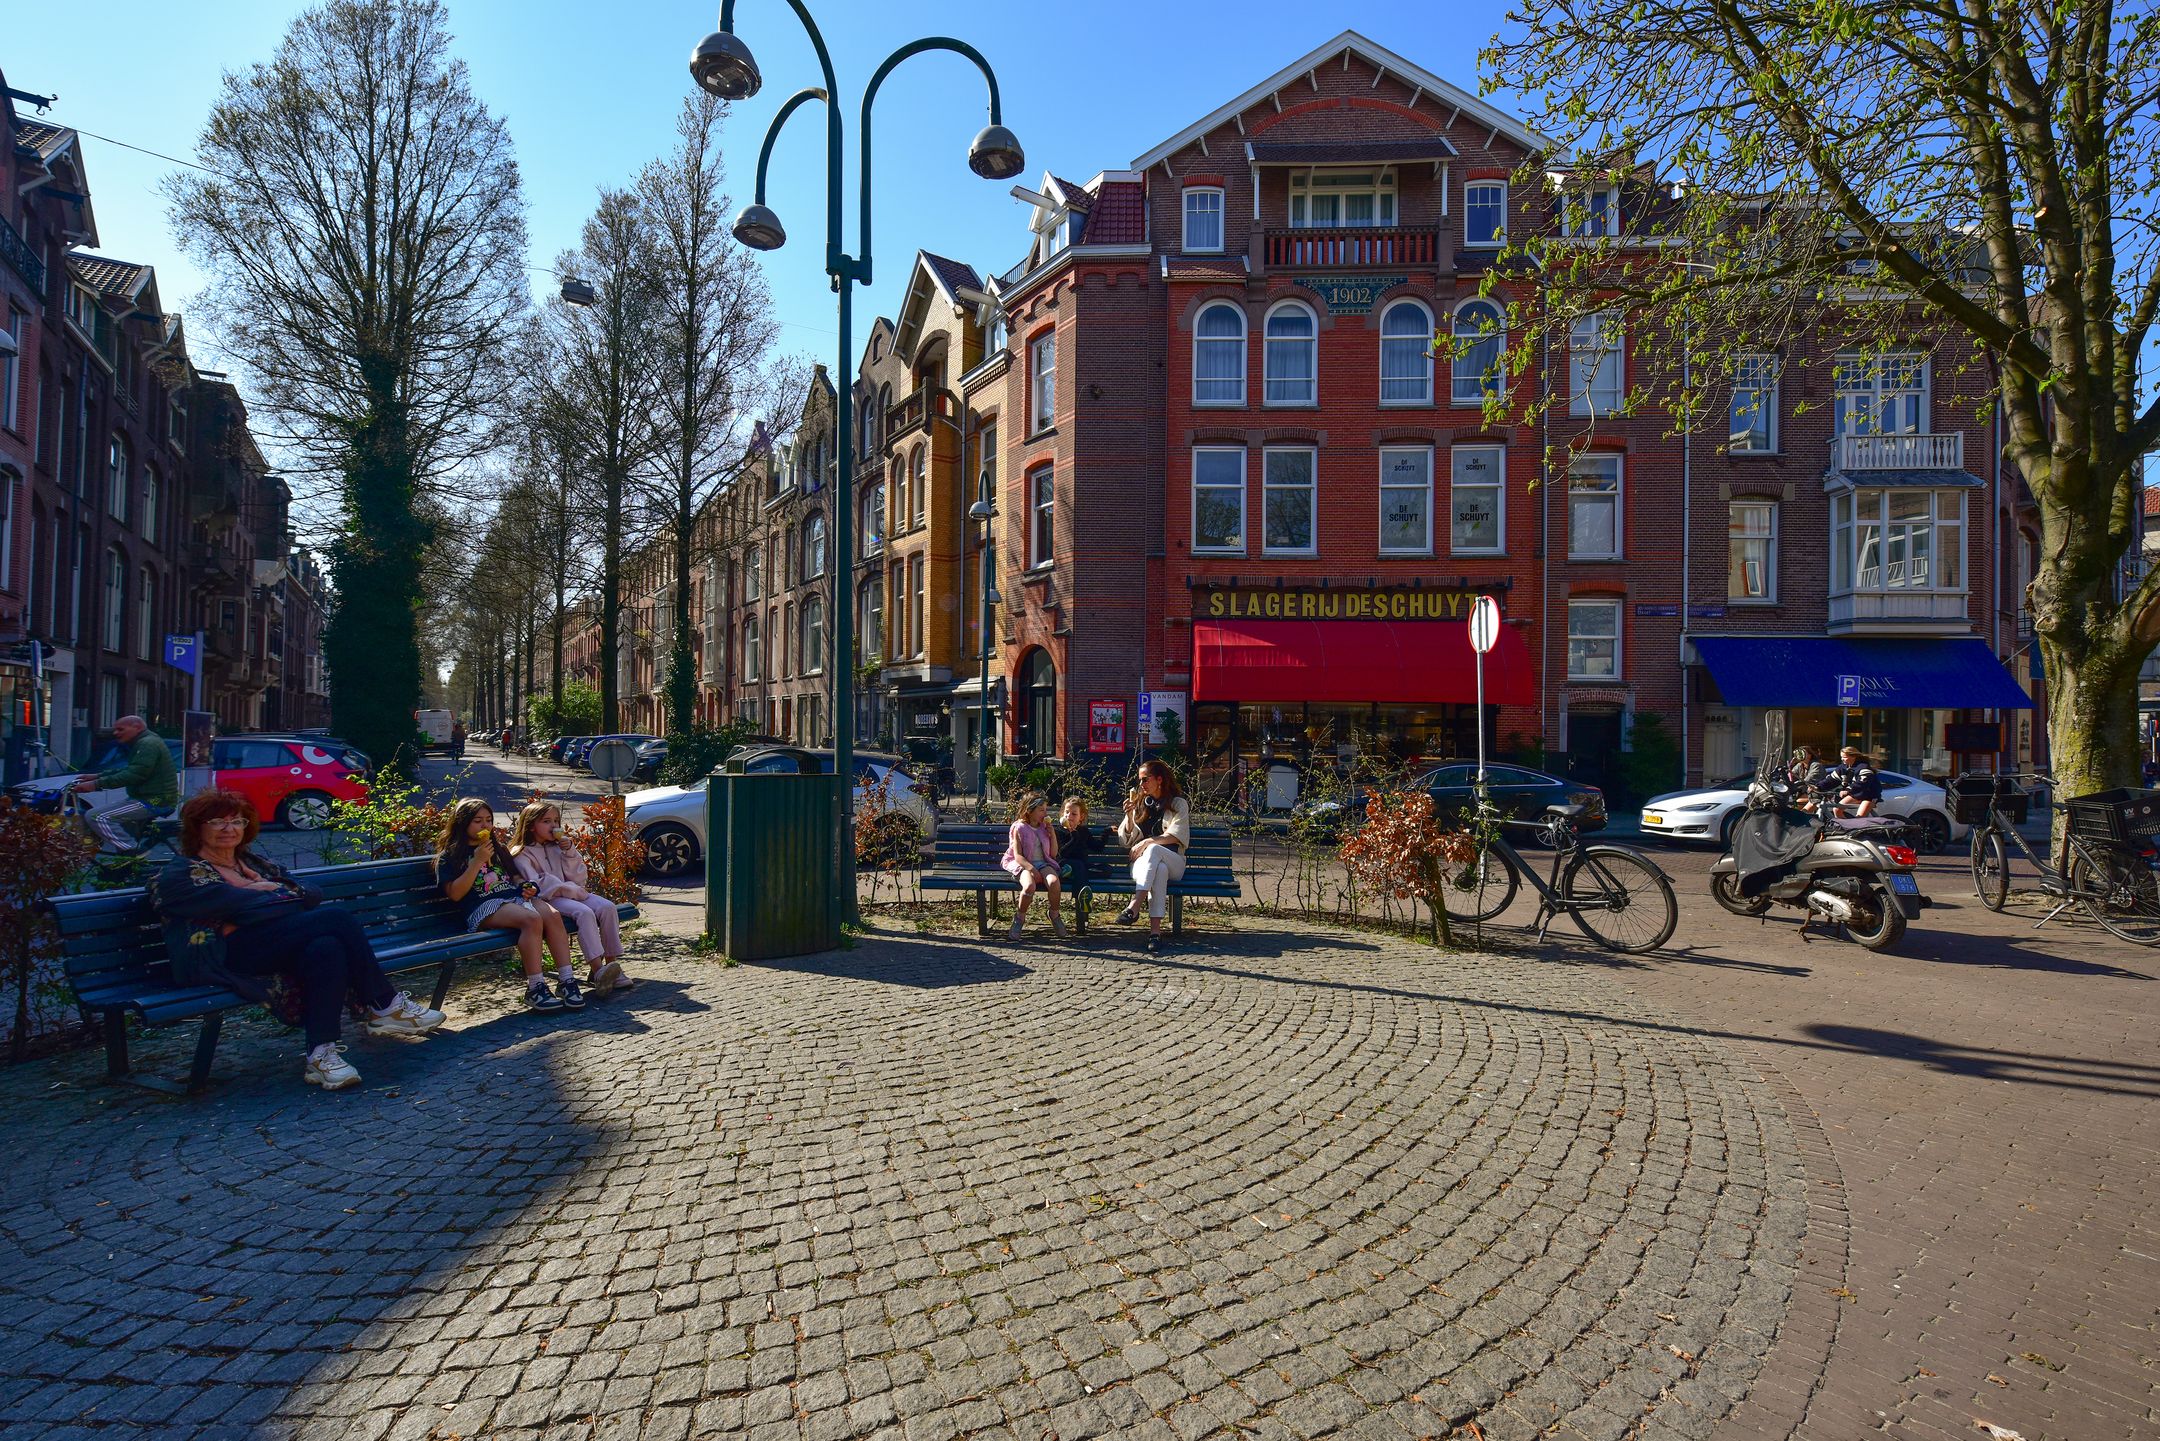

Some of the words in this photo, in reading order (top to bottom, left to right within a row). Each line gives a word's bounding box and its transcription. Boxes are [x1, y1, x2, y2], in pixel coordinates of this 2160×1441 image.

[1329, 288, 1371, 303] 1902
[1400, 505, 1408, 513] DE
[1470, 504, 1479, 512] DE
[1389, 513, 1418, 522] SCHUYT
[1460, 513, 1489, 521] SCHUYT
[1210, 592, 1339, 617] SLAGERIJ
[174, 646, 186, 660] P
[1843, 678, 1856, 693] P
[1141, 695, 1149, 710] P
